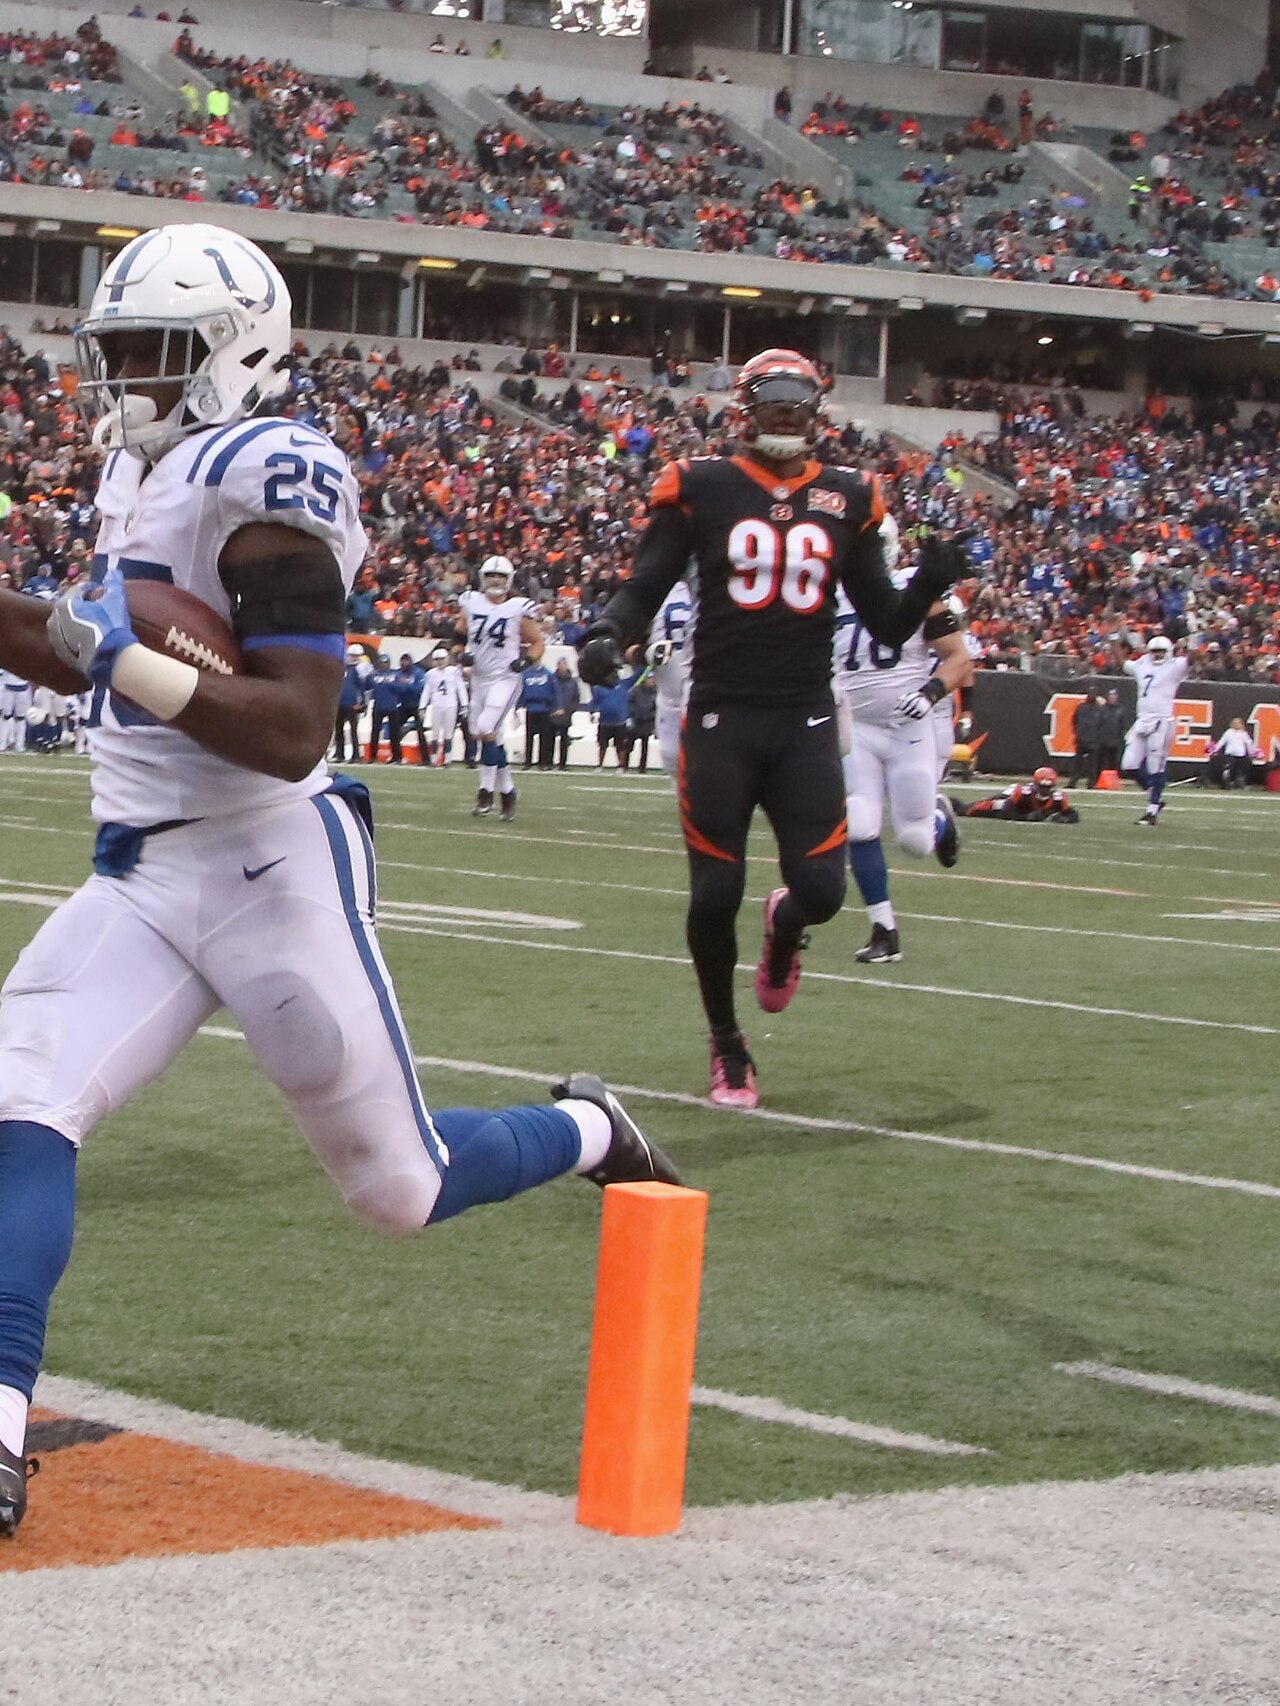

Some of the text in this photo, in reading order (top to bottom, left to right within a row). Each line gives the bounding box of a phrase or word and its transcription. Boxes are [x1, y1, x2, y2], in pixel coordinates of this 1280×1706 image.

[264, 453, 343, 523] 25
[727, 516, 832, 615] 96
[472, 614, 509, 649] 74
[437, 679, 448, 696] 4
[1142, 673, 1154, 698] 7
